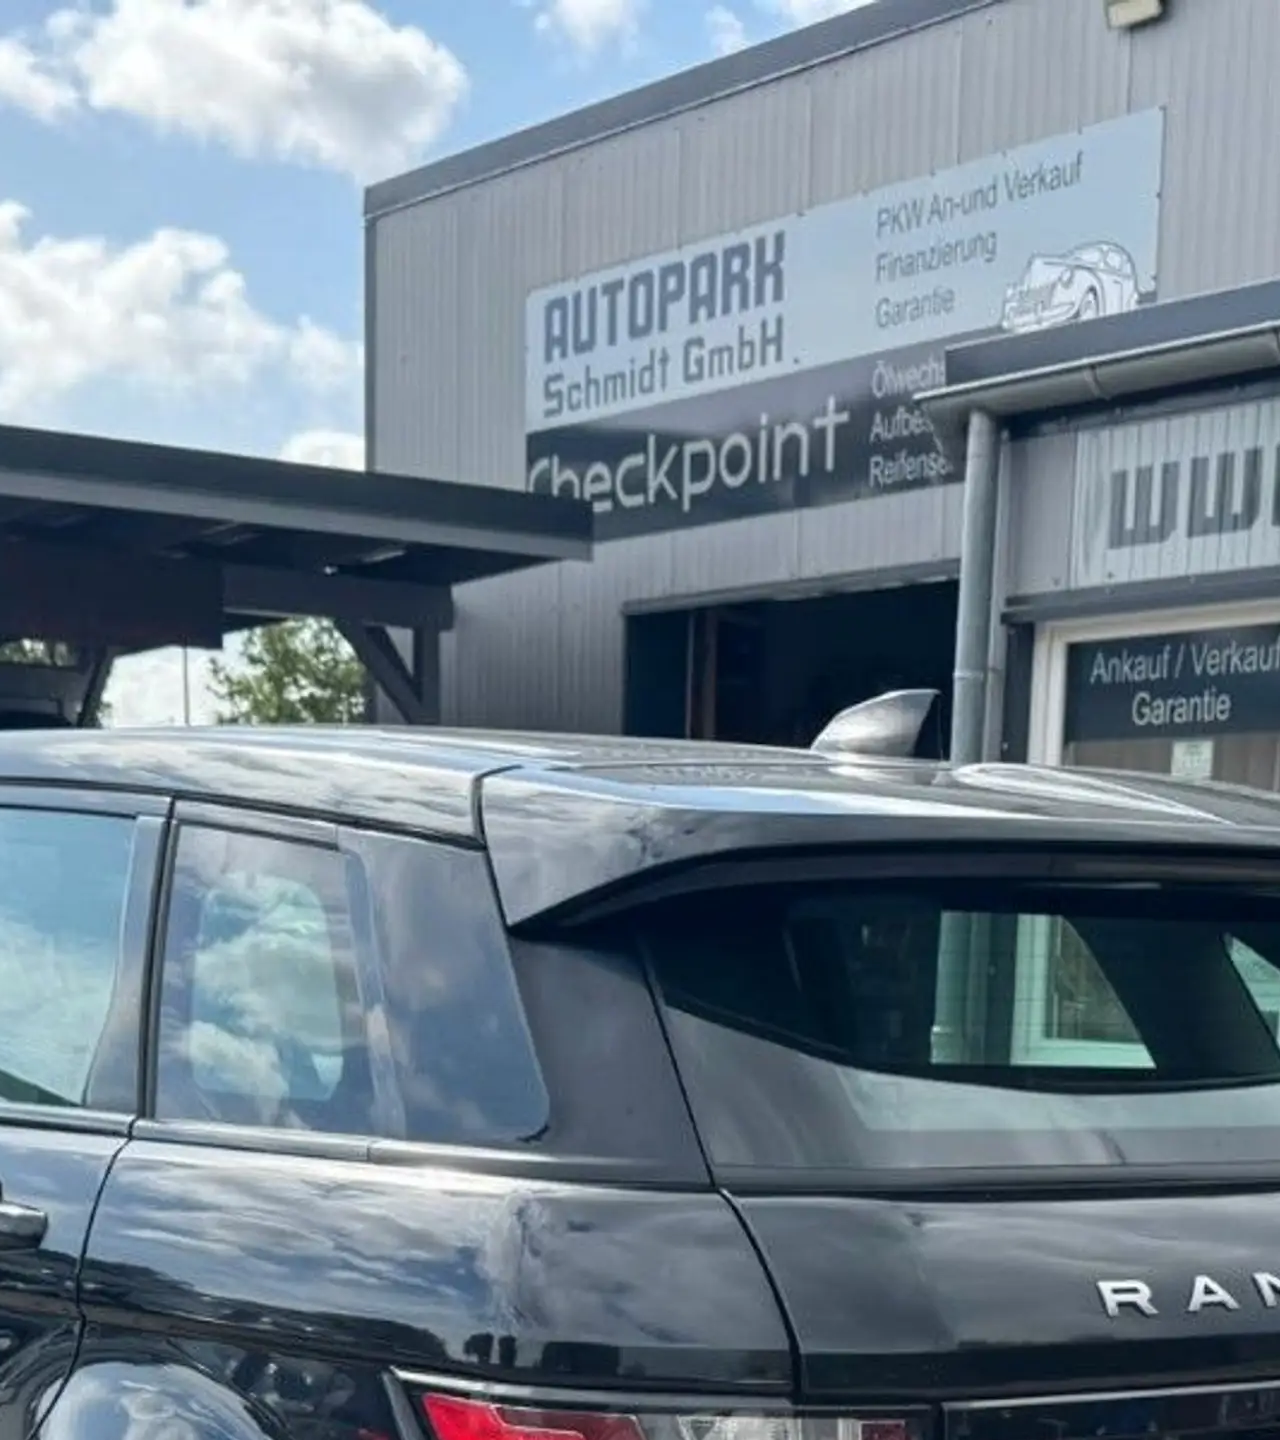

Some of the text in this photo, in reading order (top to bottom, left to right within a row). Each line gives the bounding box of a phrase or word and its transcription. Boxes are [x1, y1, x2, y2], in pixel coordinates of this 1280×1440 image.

[875, 149, 1085, 241] PKW An-und Verkauf
[875, 230, 998, 284] Finanzierung
[543, 230, 786, 364] AUTOPARK
[874, 284, 956, 329] Garantie
[543, 346, 672, 419] Schmidt
[1089, 642, 1171, 686] Ankauf
[1173, 644, 1185, 680] /
[1130, 685, 1232, 726] Garantie
